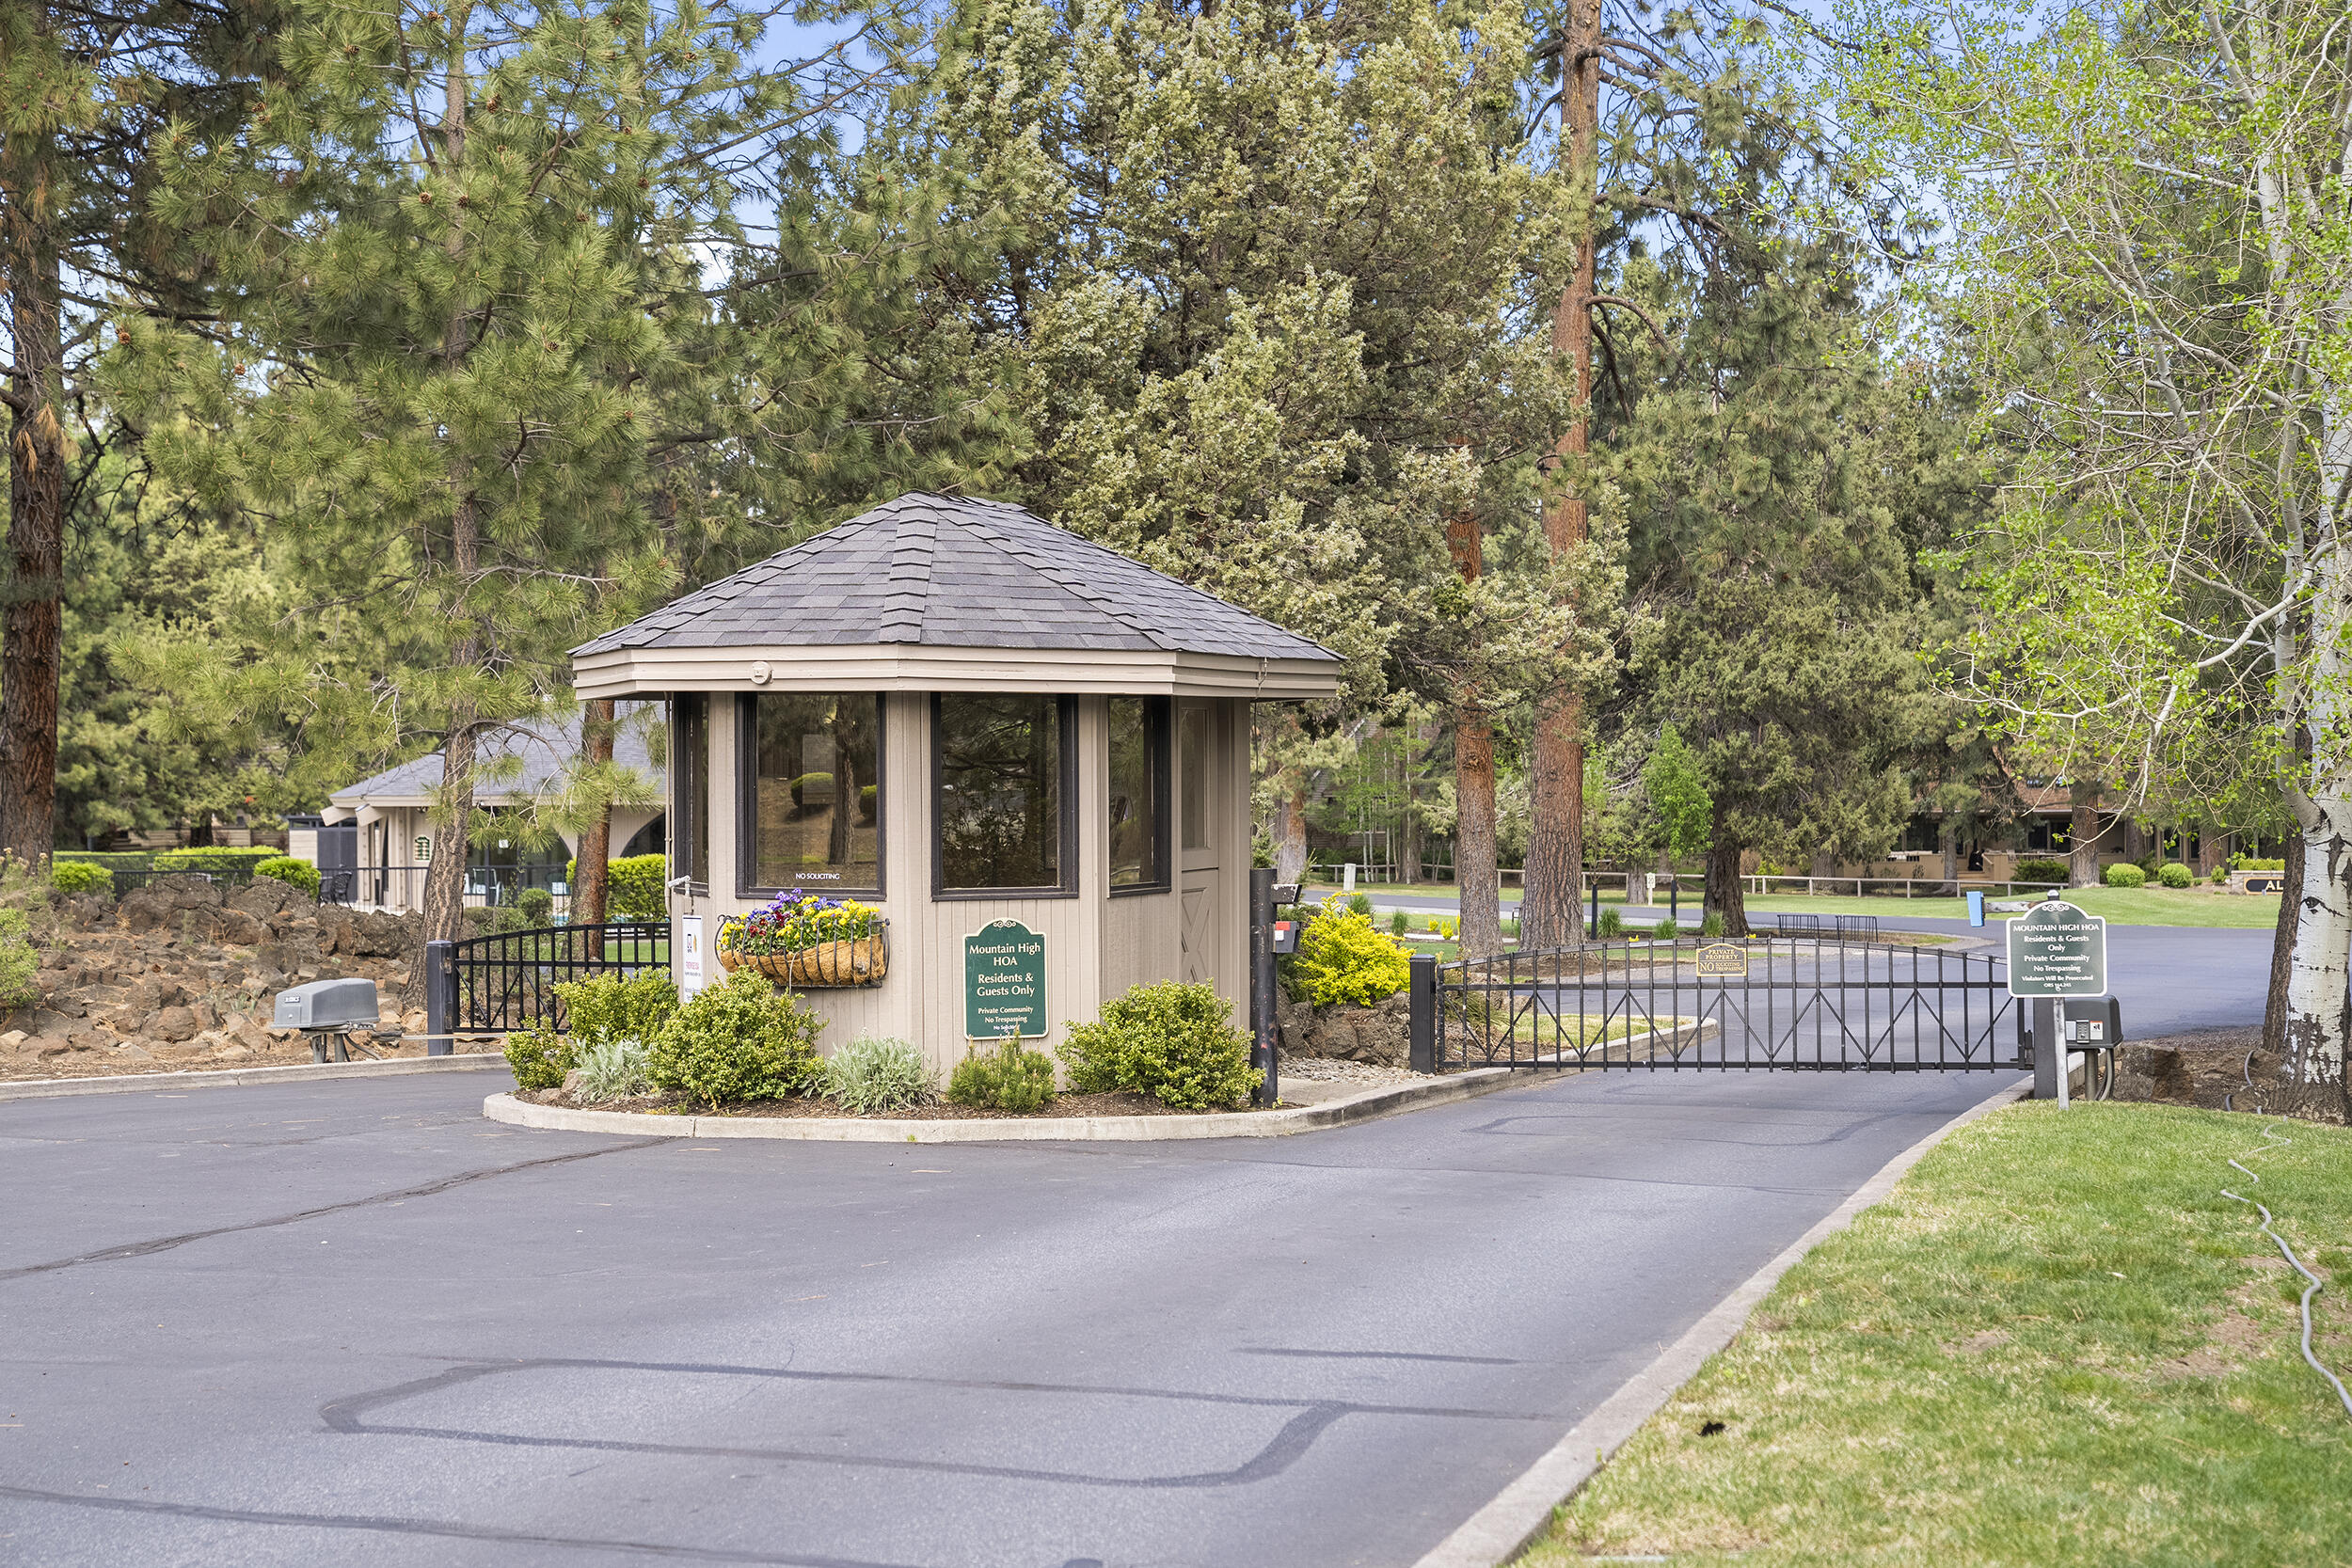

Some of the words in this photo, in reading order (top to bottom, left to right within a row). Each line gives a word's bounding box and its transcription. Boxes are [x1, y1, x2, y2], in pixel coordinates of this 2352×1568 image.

[2265, 879, 2284, 891] AL
[969, 943, 1015, 955] Mountain
[1018, 942, 1041, 956] High
[2047, 944, 2066, 953] Only
[993, 956, 1018, 966] HOA
[2049, 954, 2090, 962] Community
[1699, 961, 1715, 972] NO
[2044, 964, 2082, 974] Trespassing
[977, 974, 1023, 984] Residents
[1025, 973, 1034, 982] &
[977, 987, 1009, 997] Guests
[1011, 985, 1035, 997] Only
[1000, 1006, 1034, 1014] Community
[994, 1015, 1028, 1024] Trespassing
